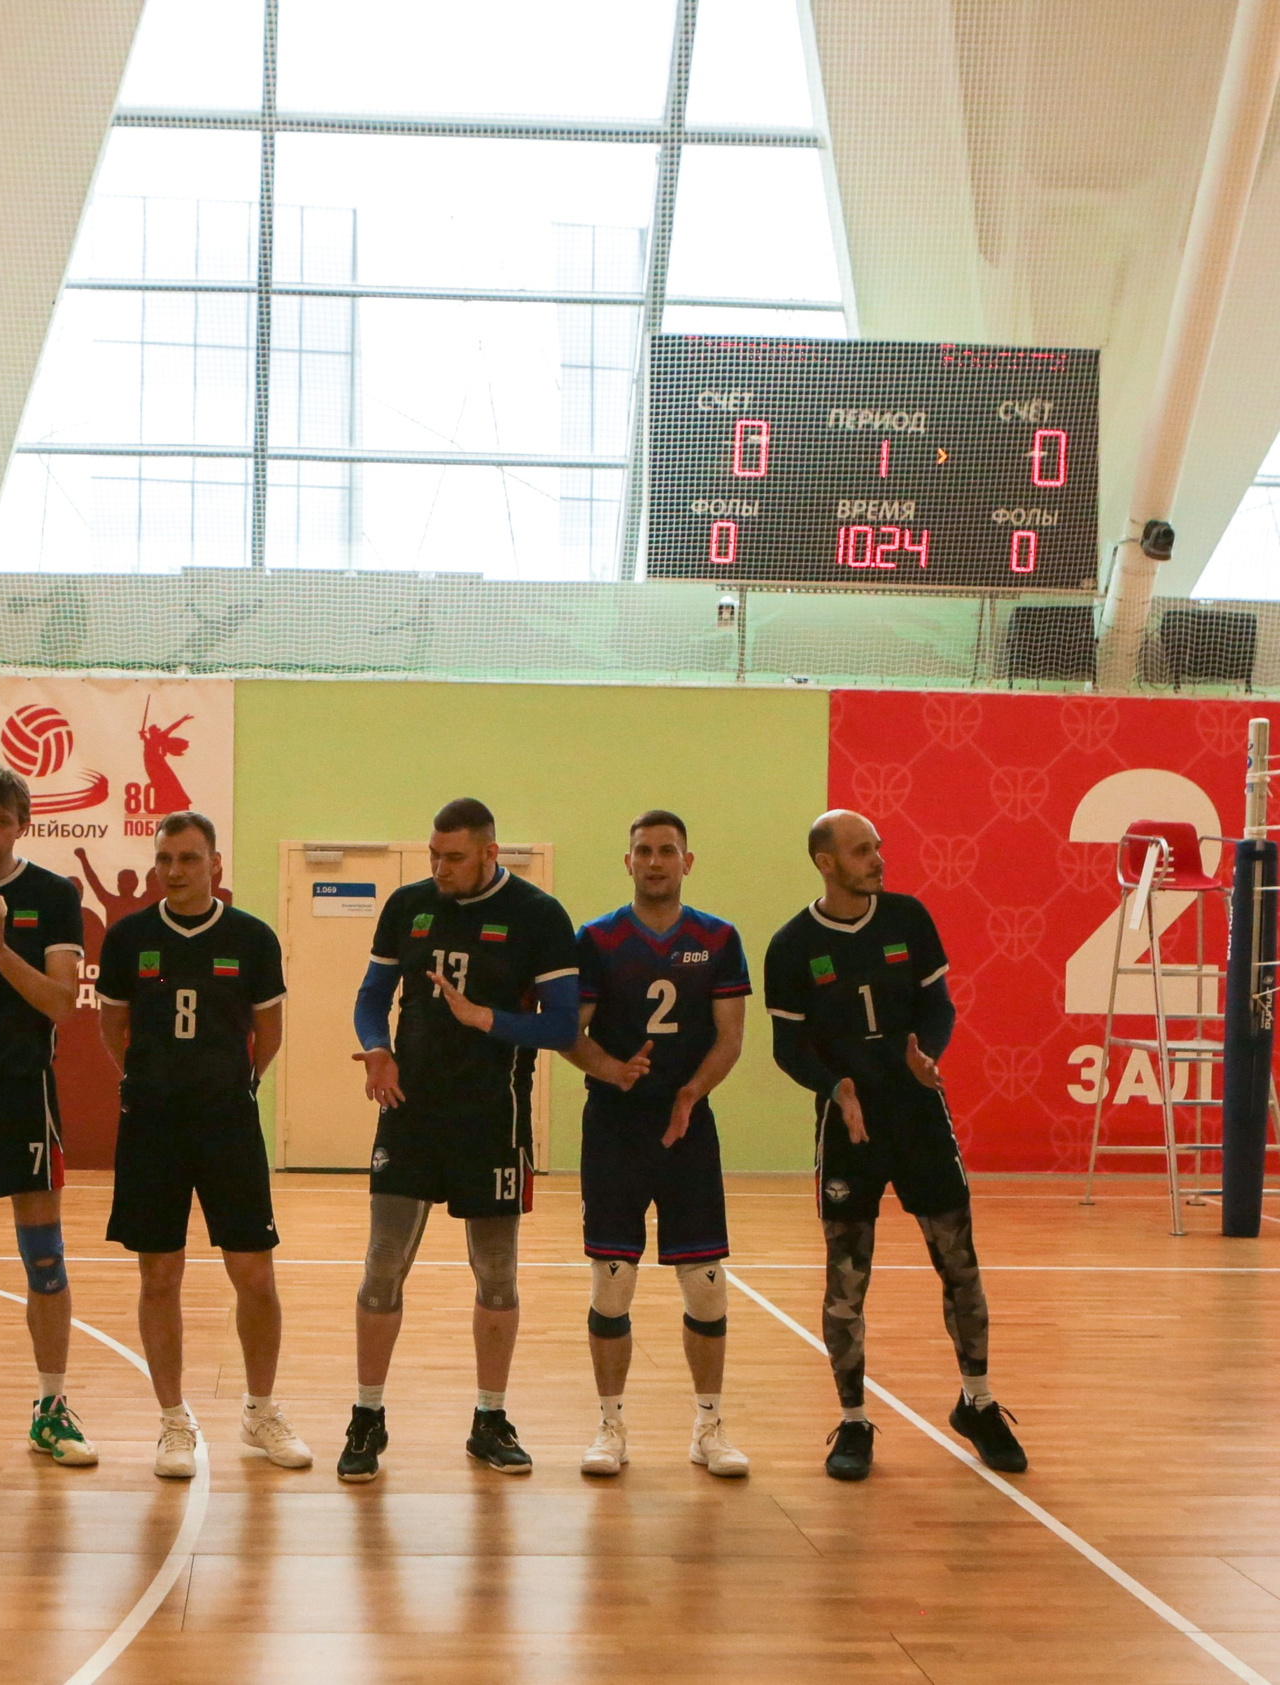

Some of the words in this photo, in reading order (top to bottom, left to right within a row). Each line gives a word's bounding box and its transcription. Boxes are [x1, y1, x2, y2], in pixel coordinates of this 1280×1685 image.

[828, 408, 926, 434] ПЕРИОД
[734, 418, 769, 478] 0
[880, 439, 890, 478] 1
[1032, 429, 1068, 488] 0
[690, 497, 760, 517] ФОЛЫ
[837, 499, 916, 520] ВРЕМЯ
[992, 508, 1059, 526] ФОЛЫ
[710, 520, 738, 565] 0
[1010, 529, 1037, 573] 0
[124, 782, 157, 815] 80
[24, 820, 109, 838] ЛЕЙБОЛУ
[124, 820, 157, 837] ПОБ
[1065, 768, 1222, 1014] 2
[432, 949, 469, 998] 13
[682, 950, 710, 963] ВФВ
[175, 989, 197, 1039] 8
[646, 979, 678, 1034] 2
[858, 985, 878, 1033] 1
[1067, 1045, 1213, 1104] ЗАЛ
[29, 1142, 43, 1175] 7
[493, 1167, 516, 1200] 13
